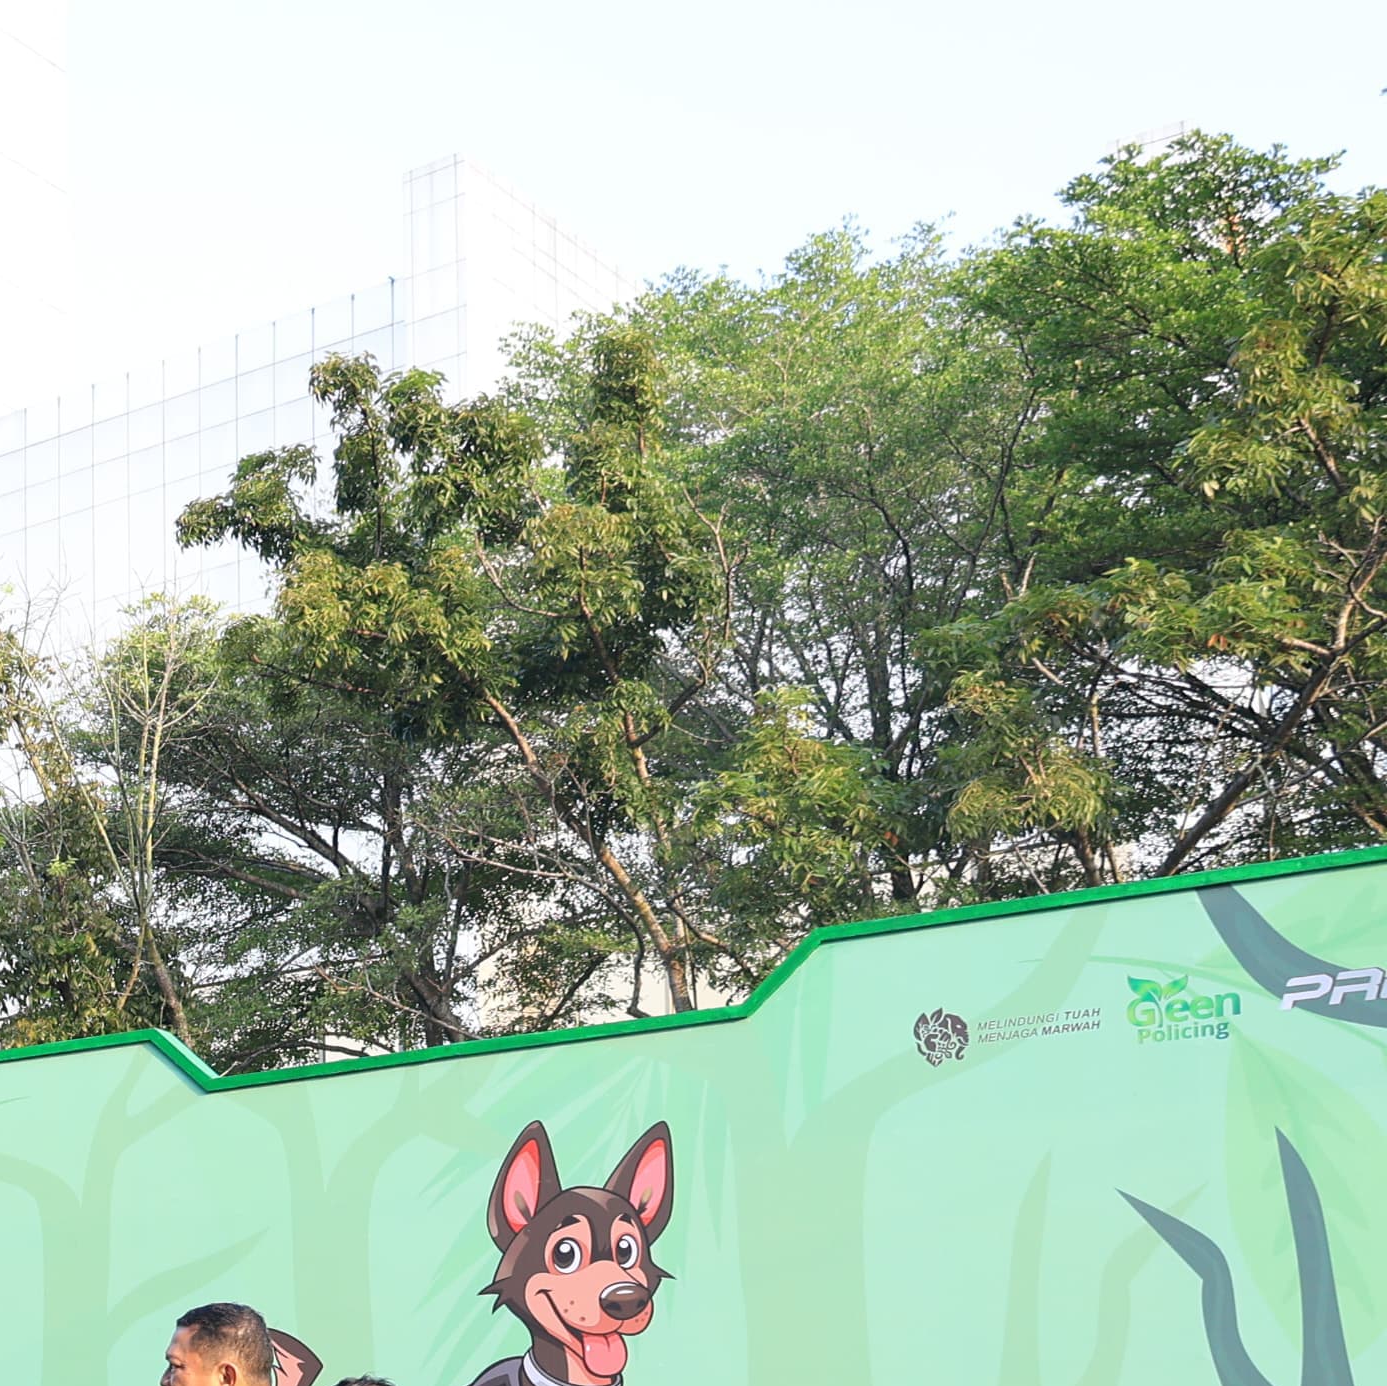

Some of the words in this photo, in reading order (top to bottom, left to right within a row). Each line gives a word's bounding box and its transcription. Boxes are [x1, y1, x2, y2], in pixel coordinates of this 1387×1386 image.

[1281, 967, 1387, 1011] PR
[1126, 986, 1241, 1027] Green
[977, 1012, 1059, 1031] MELINDUNGI
[1064, 1007, 1101, 1021] TUAH
[977, 1028, 1038, 1043] MENJAGA
[1041, 1020, 1101, 1036] MARWAH
[1137, 1021, 1230, 1044] Policing
